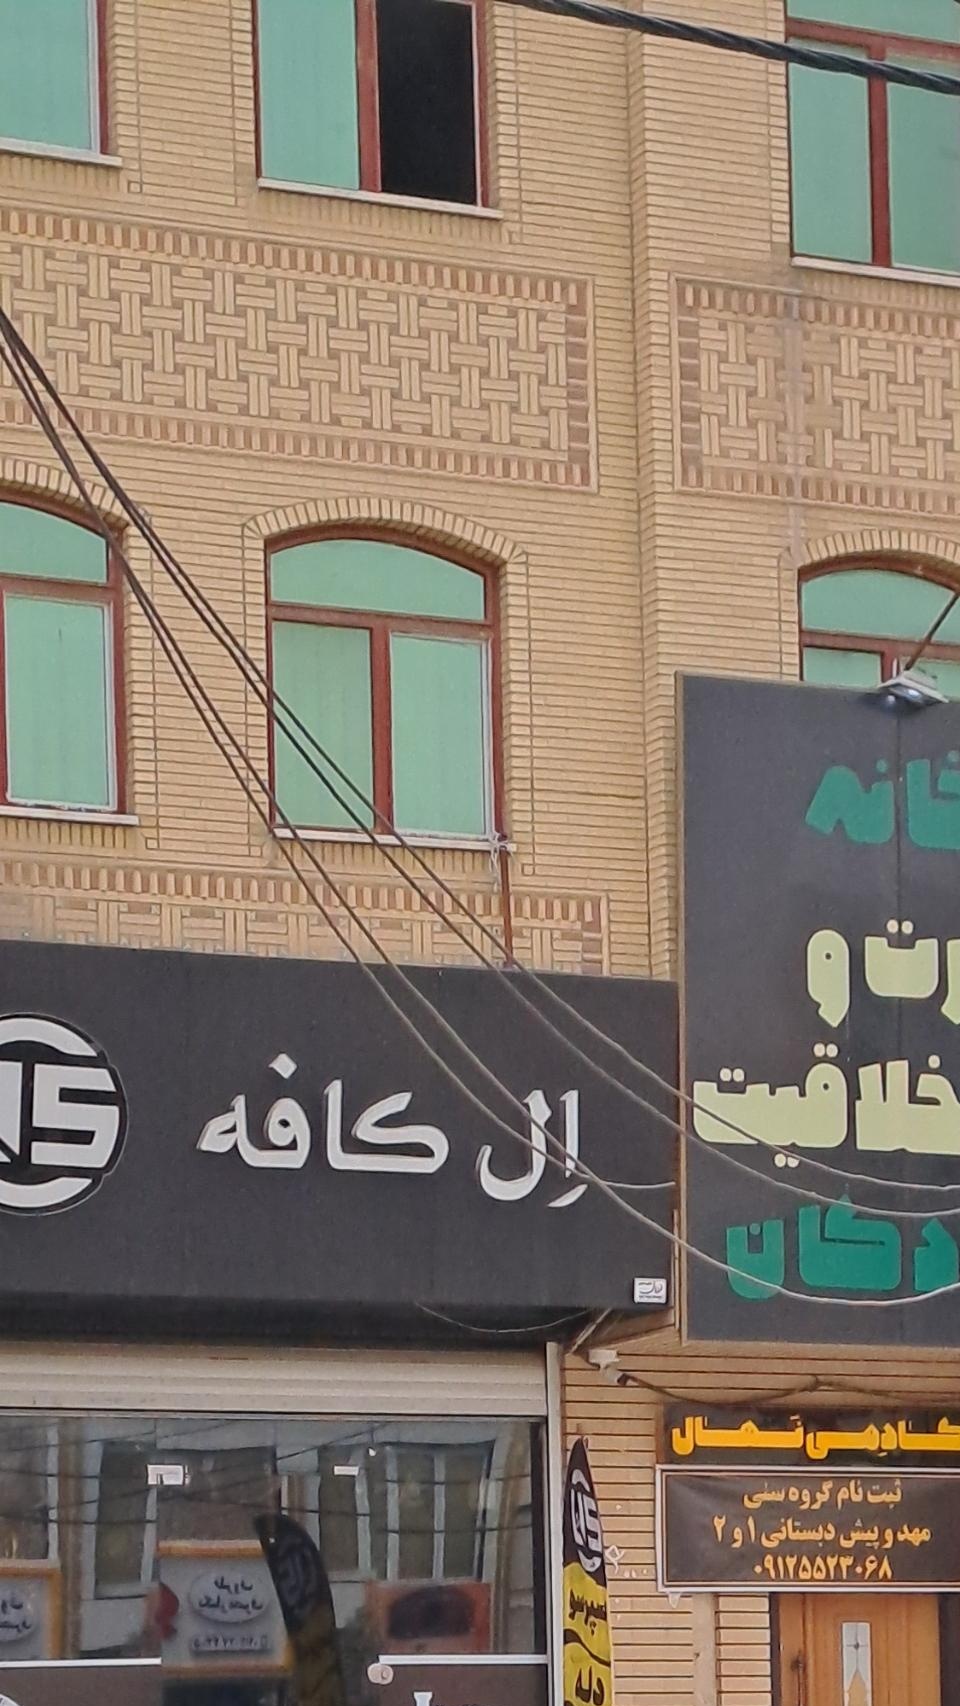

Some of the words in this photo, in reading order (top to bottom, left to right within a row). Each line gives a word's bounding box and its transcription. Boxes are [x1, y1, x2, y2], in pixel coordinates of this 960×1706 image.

[806, 929, 850, 1028] و
[197, 1053, 451, 1173] کافه
[743, 1481, 785, 1509] سنی
[788, 1480, 834, 1511] گروه
[837, 1480, 863, 1510] نام
[867, 1479, 902, 1510] ثبت
[731, 1525, 743, 1549] و
[761, 1515, 836, 1549] دبستانی
[839, 1517, 879, 1550] پیش
[883, 1525, 893, 1549] و
[897, 1519, 932, 1543] مهد
